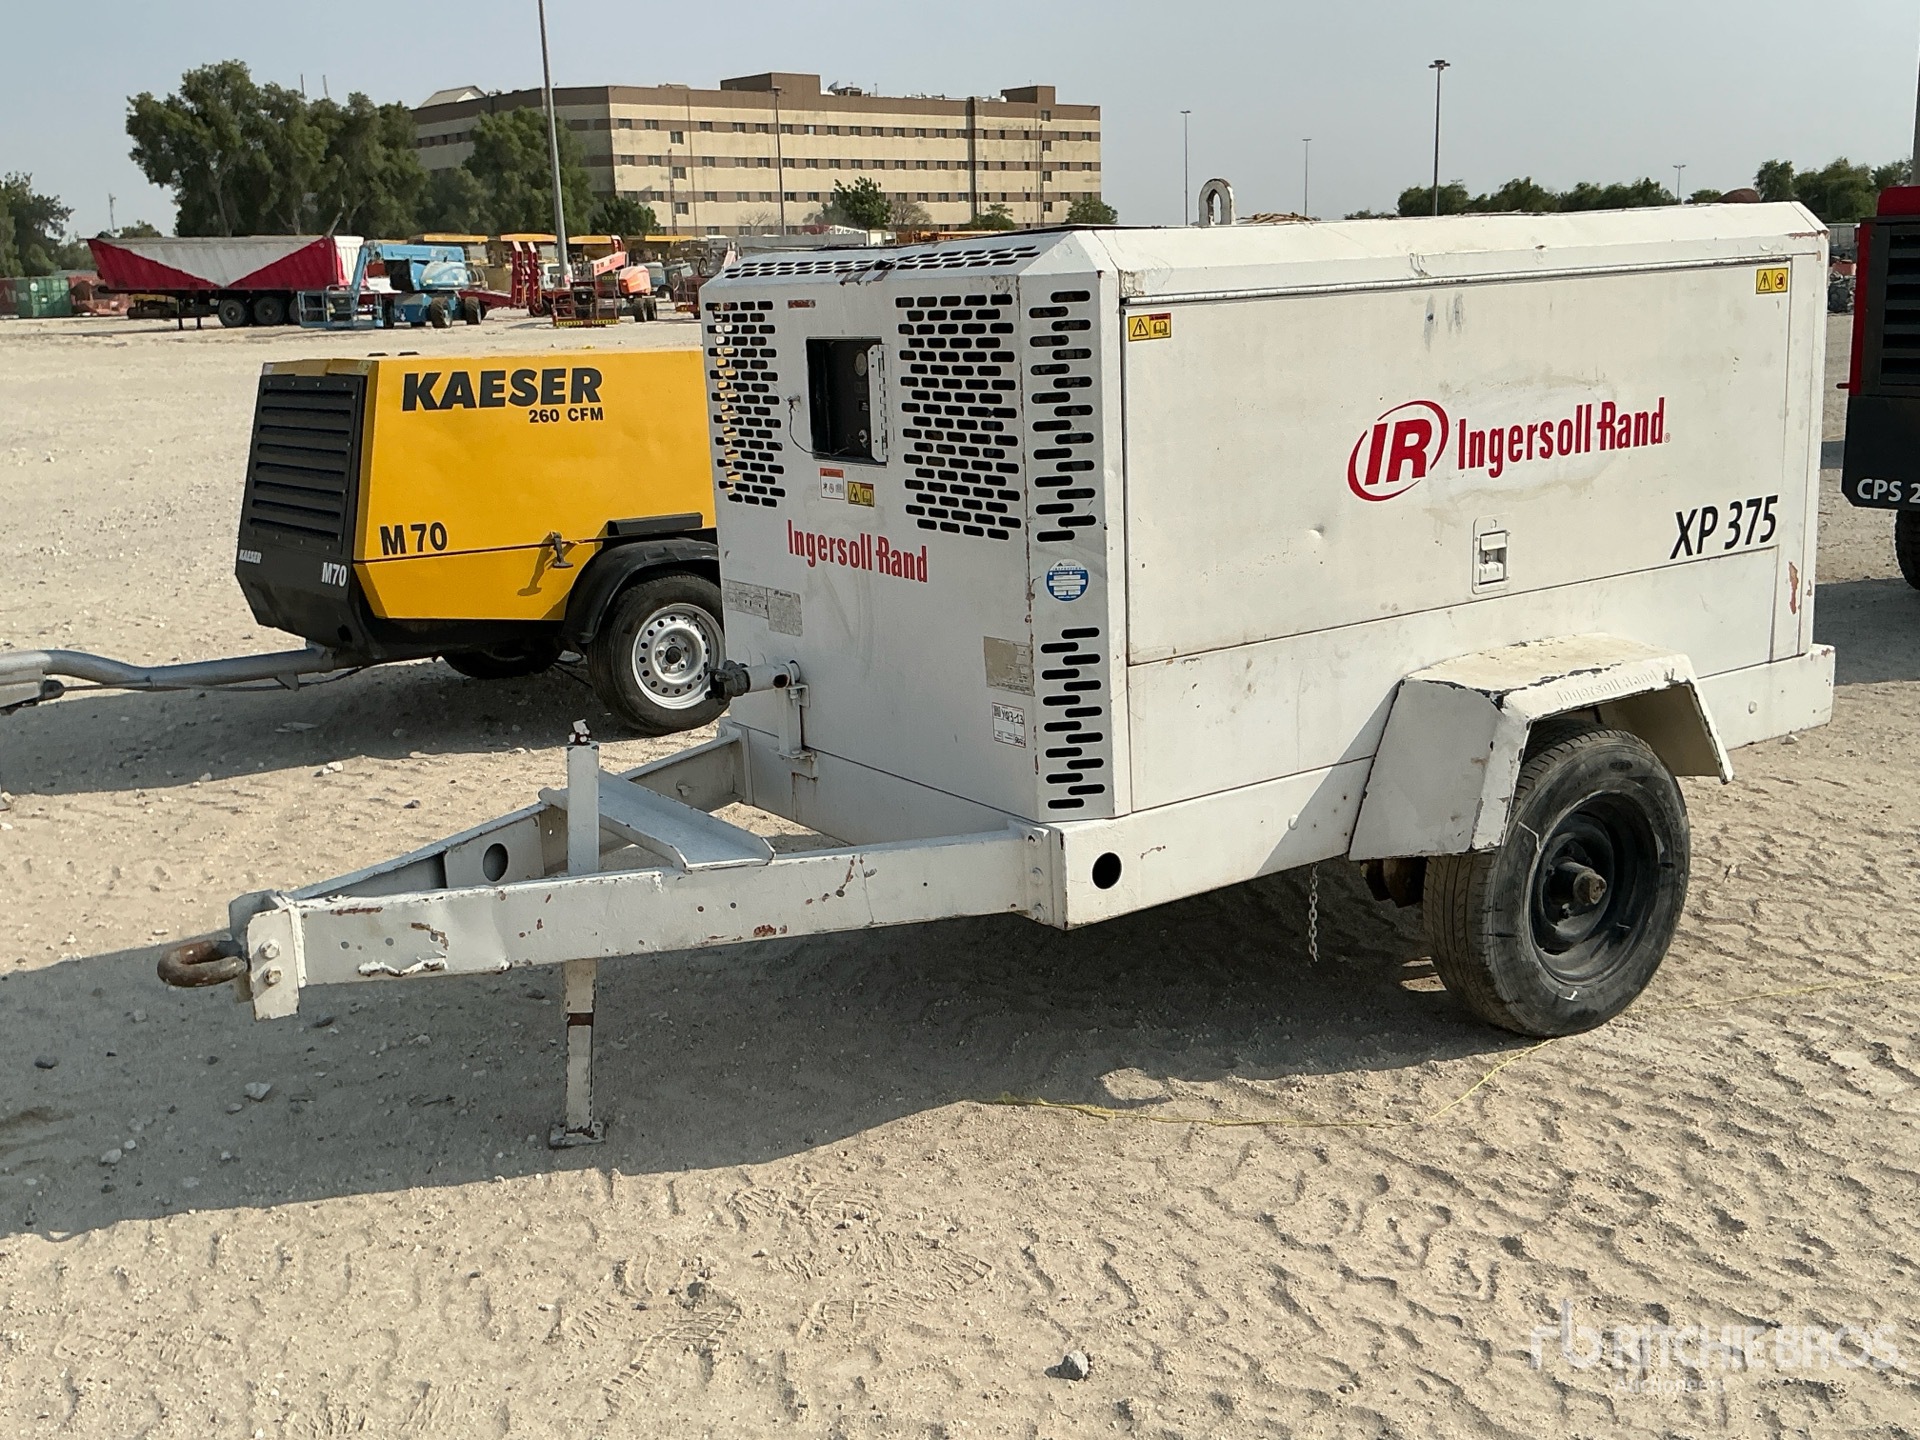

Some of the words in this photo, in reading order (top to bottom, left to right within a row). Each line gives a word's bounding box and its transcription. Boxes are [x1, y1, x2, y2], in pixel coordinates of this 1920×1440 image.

[402, 367, 603, 411] KAESER
[529, 409, 560, 423] 260
[567, 407, 604, 422] CFM
[1364, 418, 1432, 486] IR
[1457, 403, 1592, 478] Ingersoll
[1596, 397, 1665, 451] Rand
[1857, 478, 1902, 502] CPS
[1909, 483, 1920, 504] 2
[379, 524, 407, 556] M
[410, 521, 448, 553] 70
[1670, 505, 1719, 560] XP
[1724, 495, 1779, 550] 375
[787, 519, 873, 568] Ingersoll
[876, 535, 928, 583] Rand
[321, 562, 347, 587] M70
